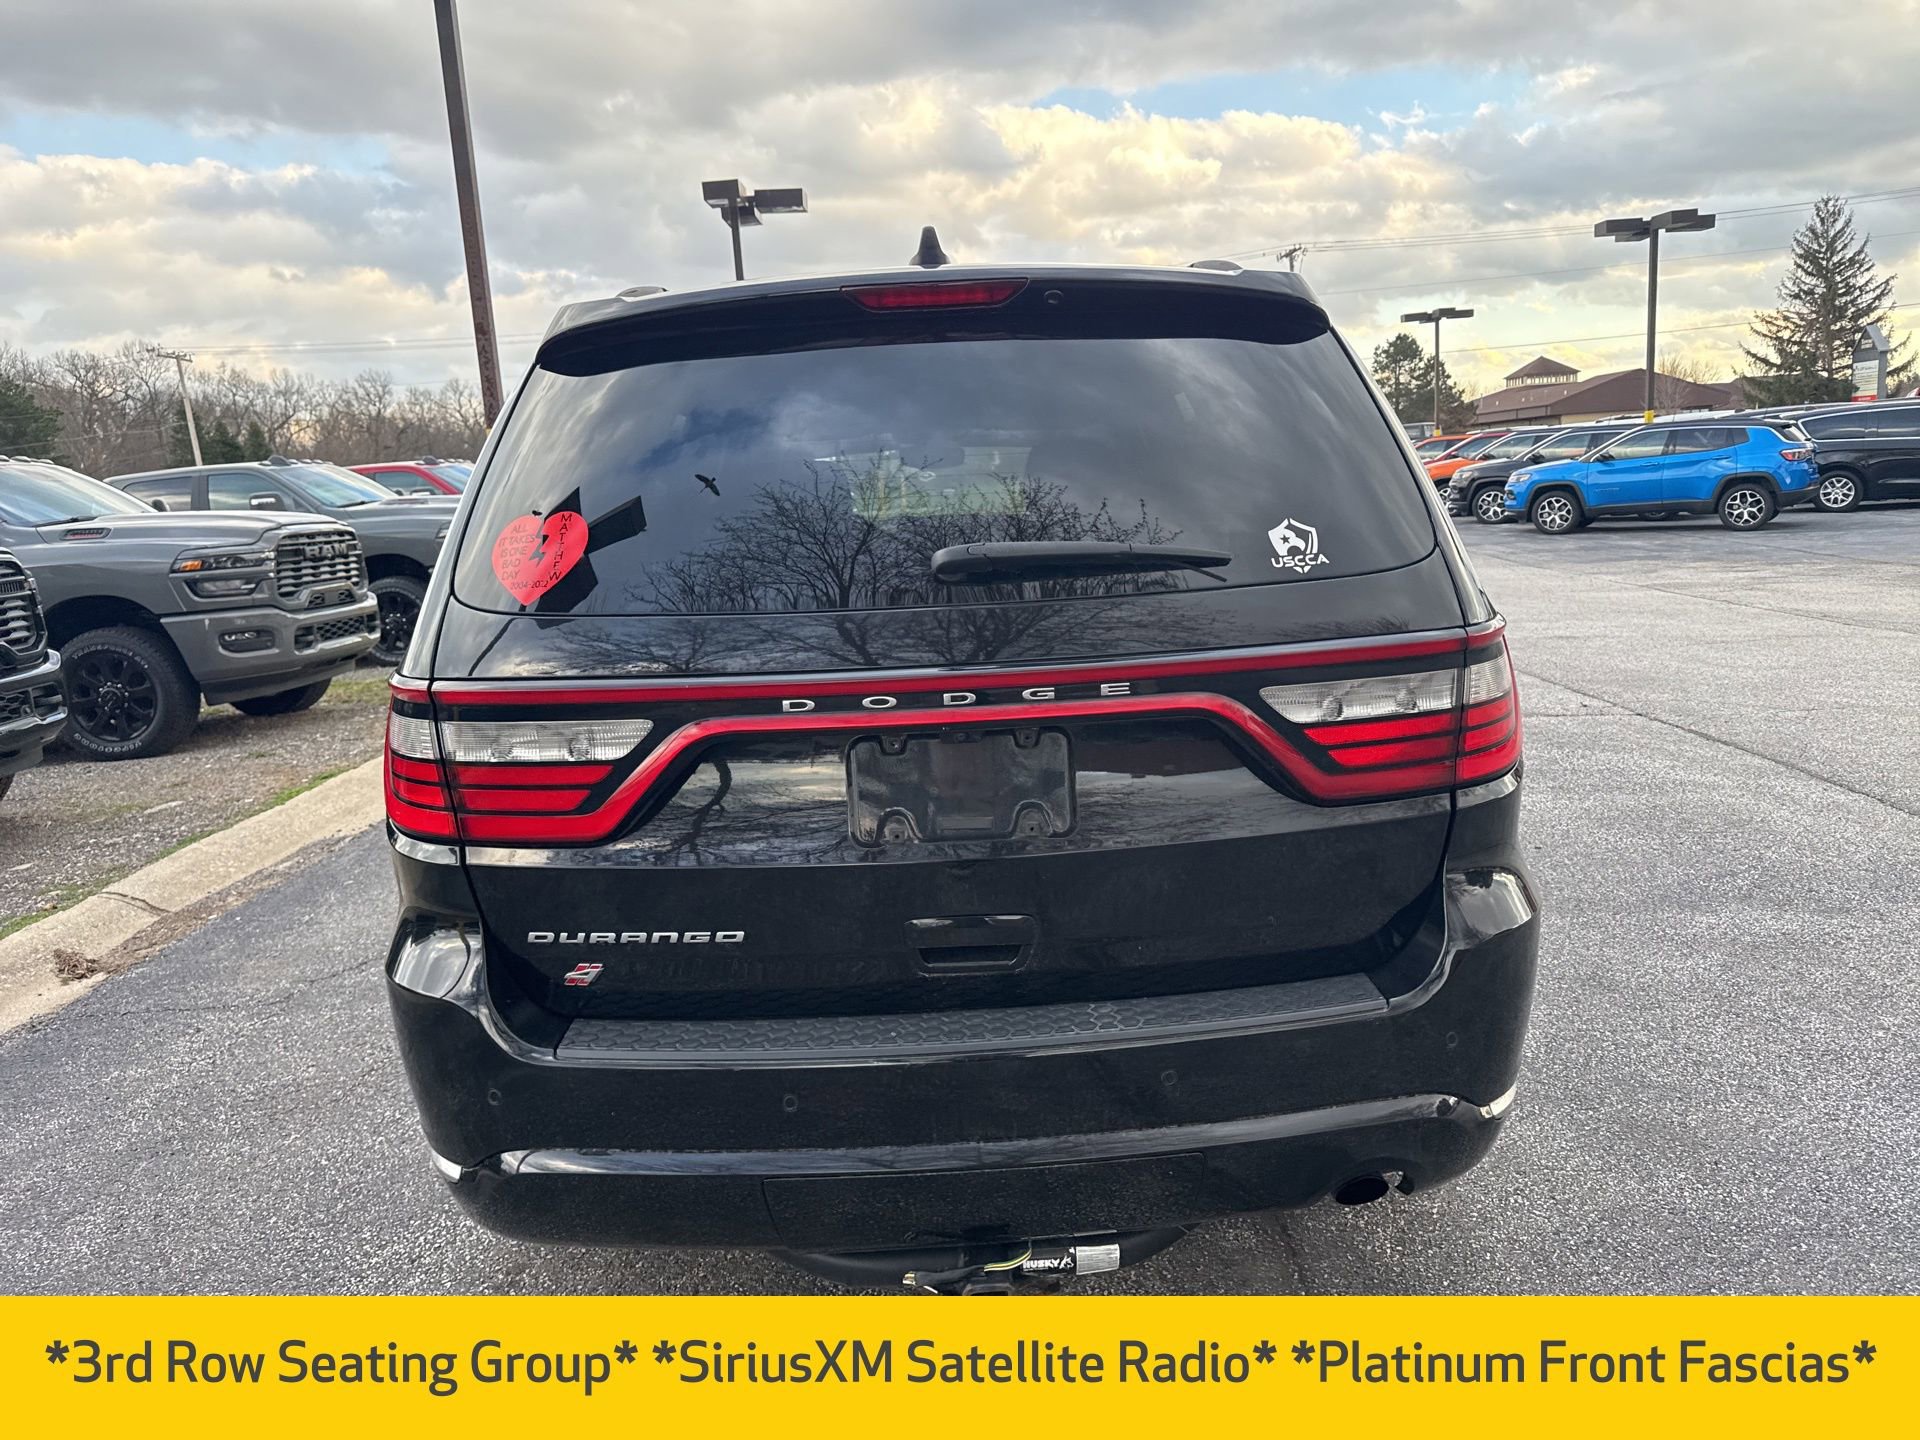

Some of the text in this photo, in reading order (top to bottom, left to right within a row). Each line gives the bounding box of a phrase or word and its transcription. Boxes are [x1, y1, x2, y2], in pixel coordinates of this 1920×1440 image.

[511, 524, 529, 534] ALL
[508, 534, 535, 545] TAKES
[304, 543, 348, 560] RAM
[509, 546, 527, 556] ONE
[502, 559, 521, 568] BAD
[1271, 553, 1330, 568] USCCA
[502, 570, 520, 580] DAY
[782, 682, 1131, 713] DODGE
[527, 930, 745, 944] DURANGO
[1022, 1258, 1060, 1269] HUSKY
